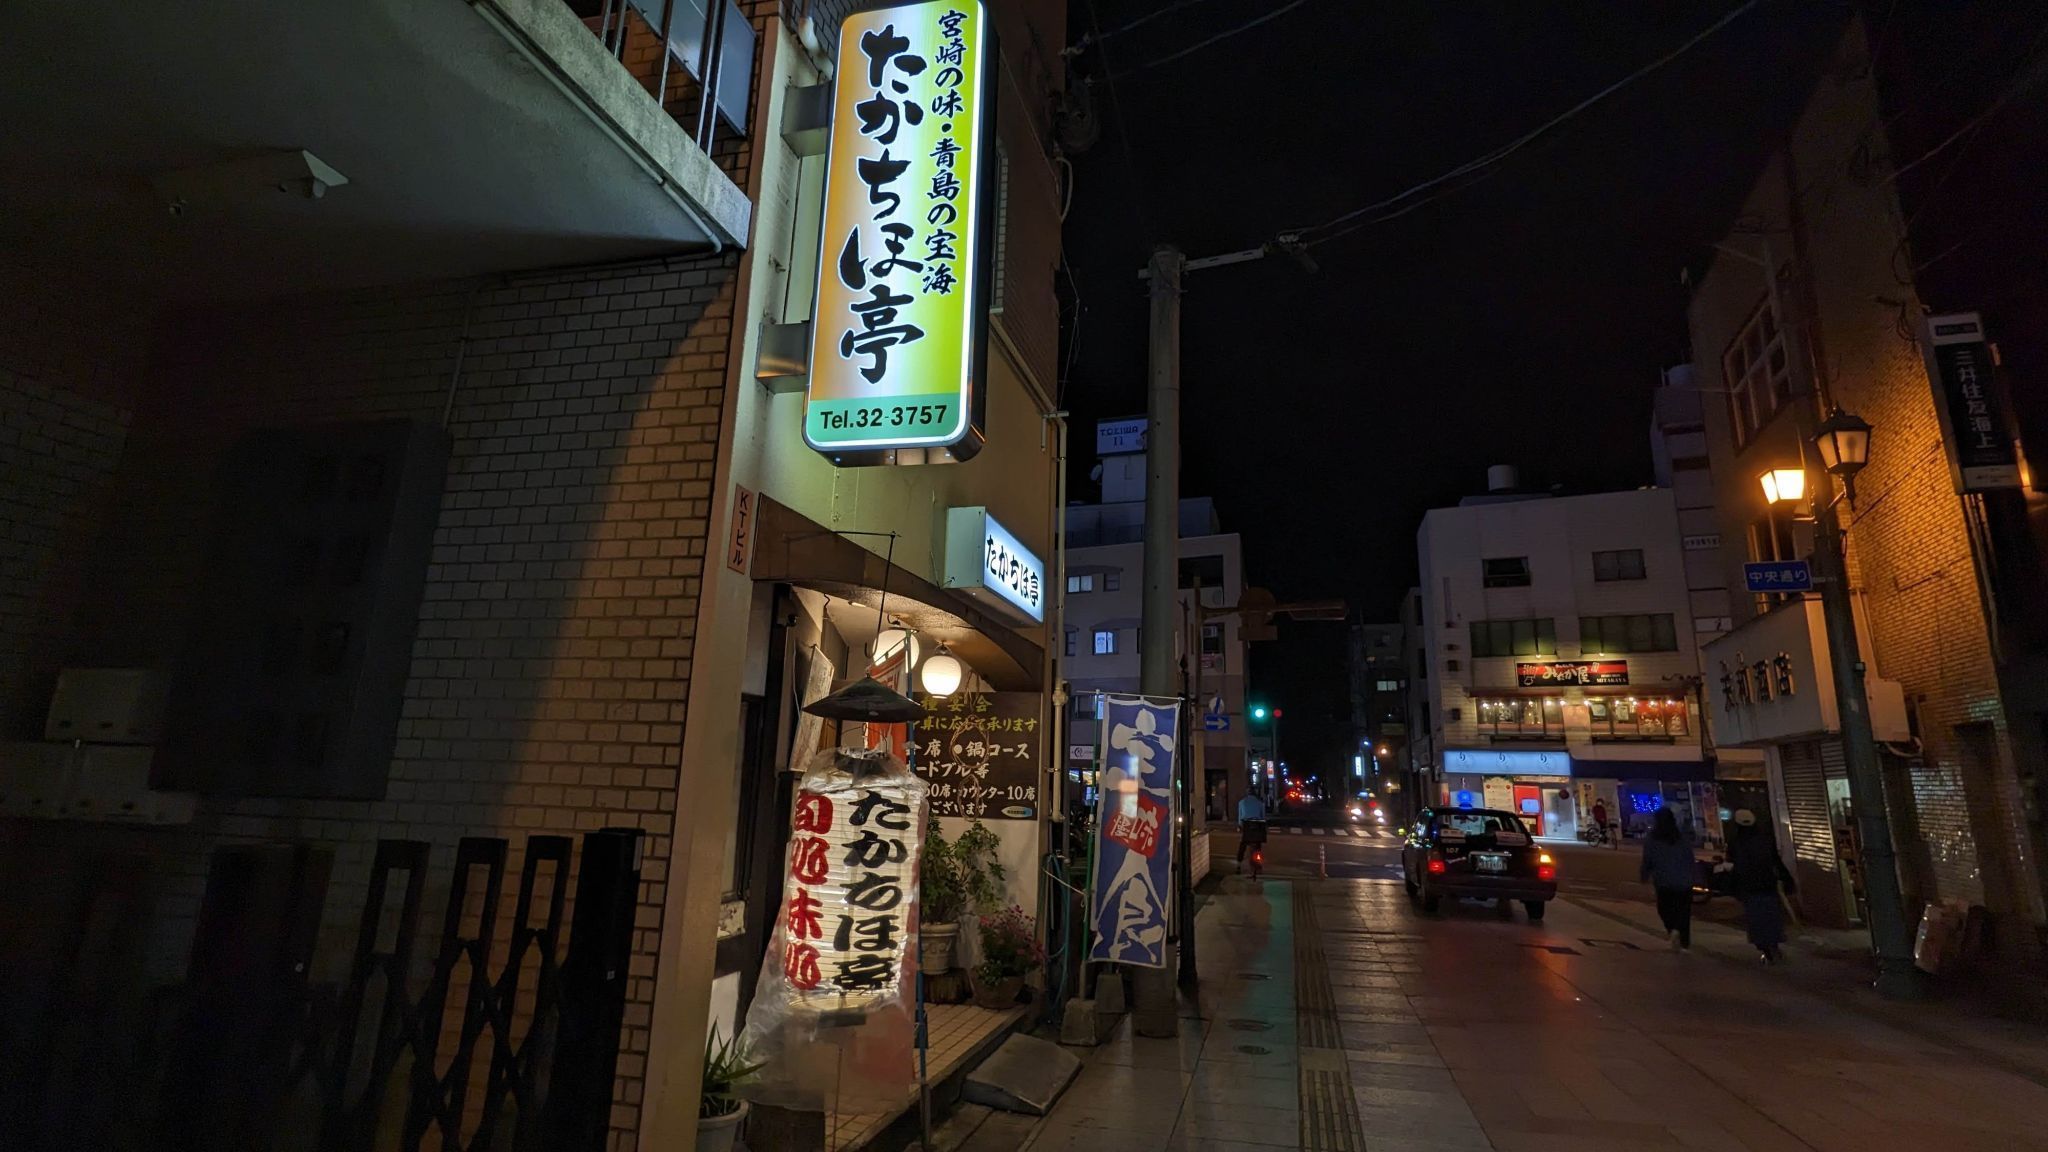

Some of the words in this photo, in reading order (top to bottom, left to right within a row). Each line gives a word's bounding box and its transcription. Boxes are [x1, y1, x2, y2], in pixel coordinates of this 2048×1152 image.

[922, 9, 968, 295] 宮崎の味・青島の宝海
[839, 23, 926, 385] たかちほ亭
[820, 404, 947, 430] Tel.32-3757
[986, 533, 1039, 608] たかちほ亭
[1748, 569, 1808, 583] 中央通り
